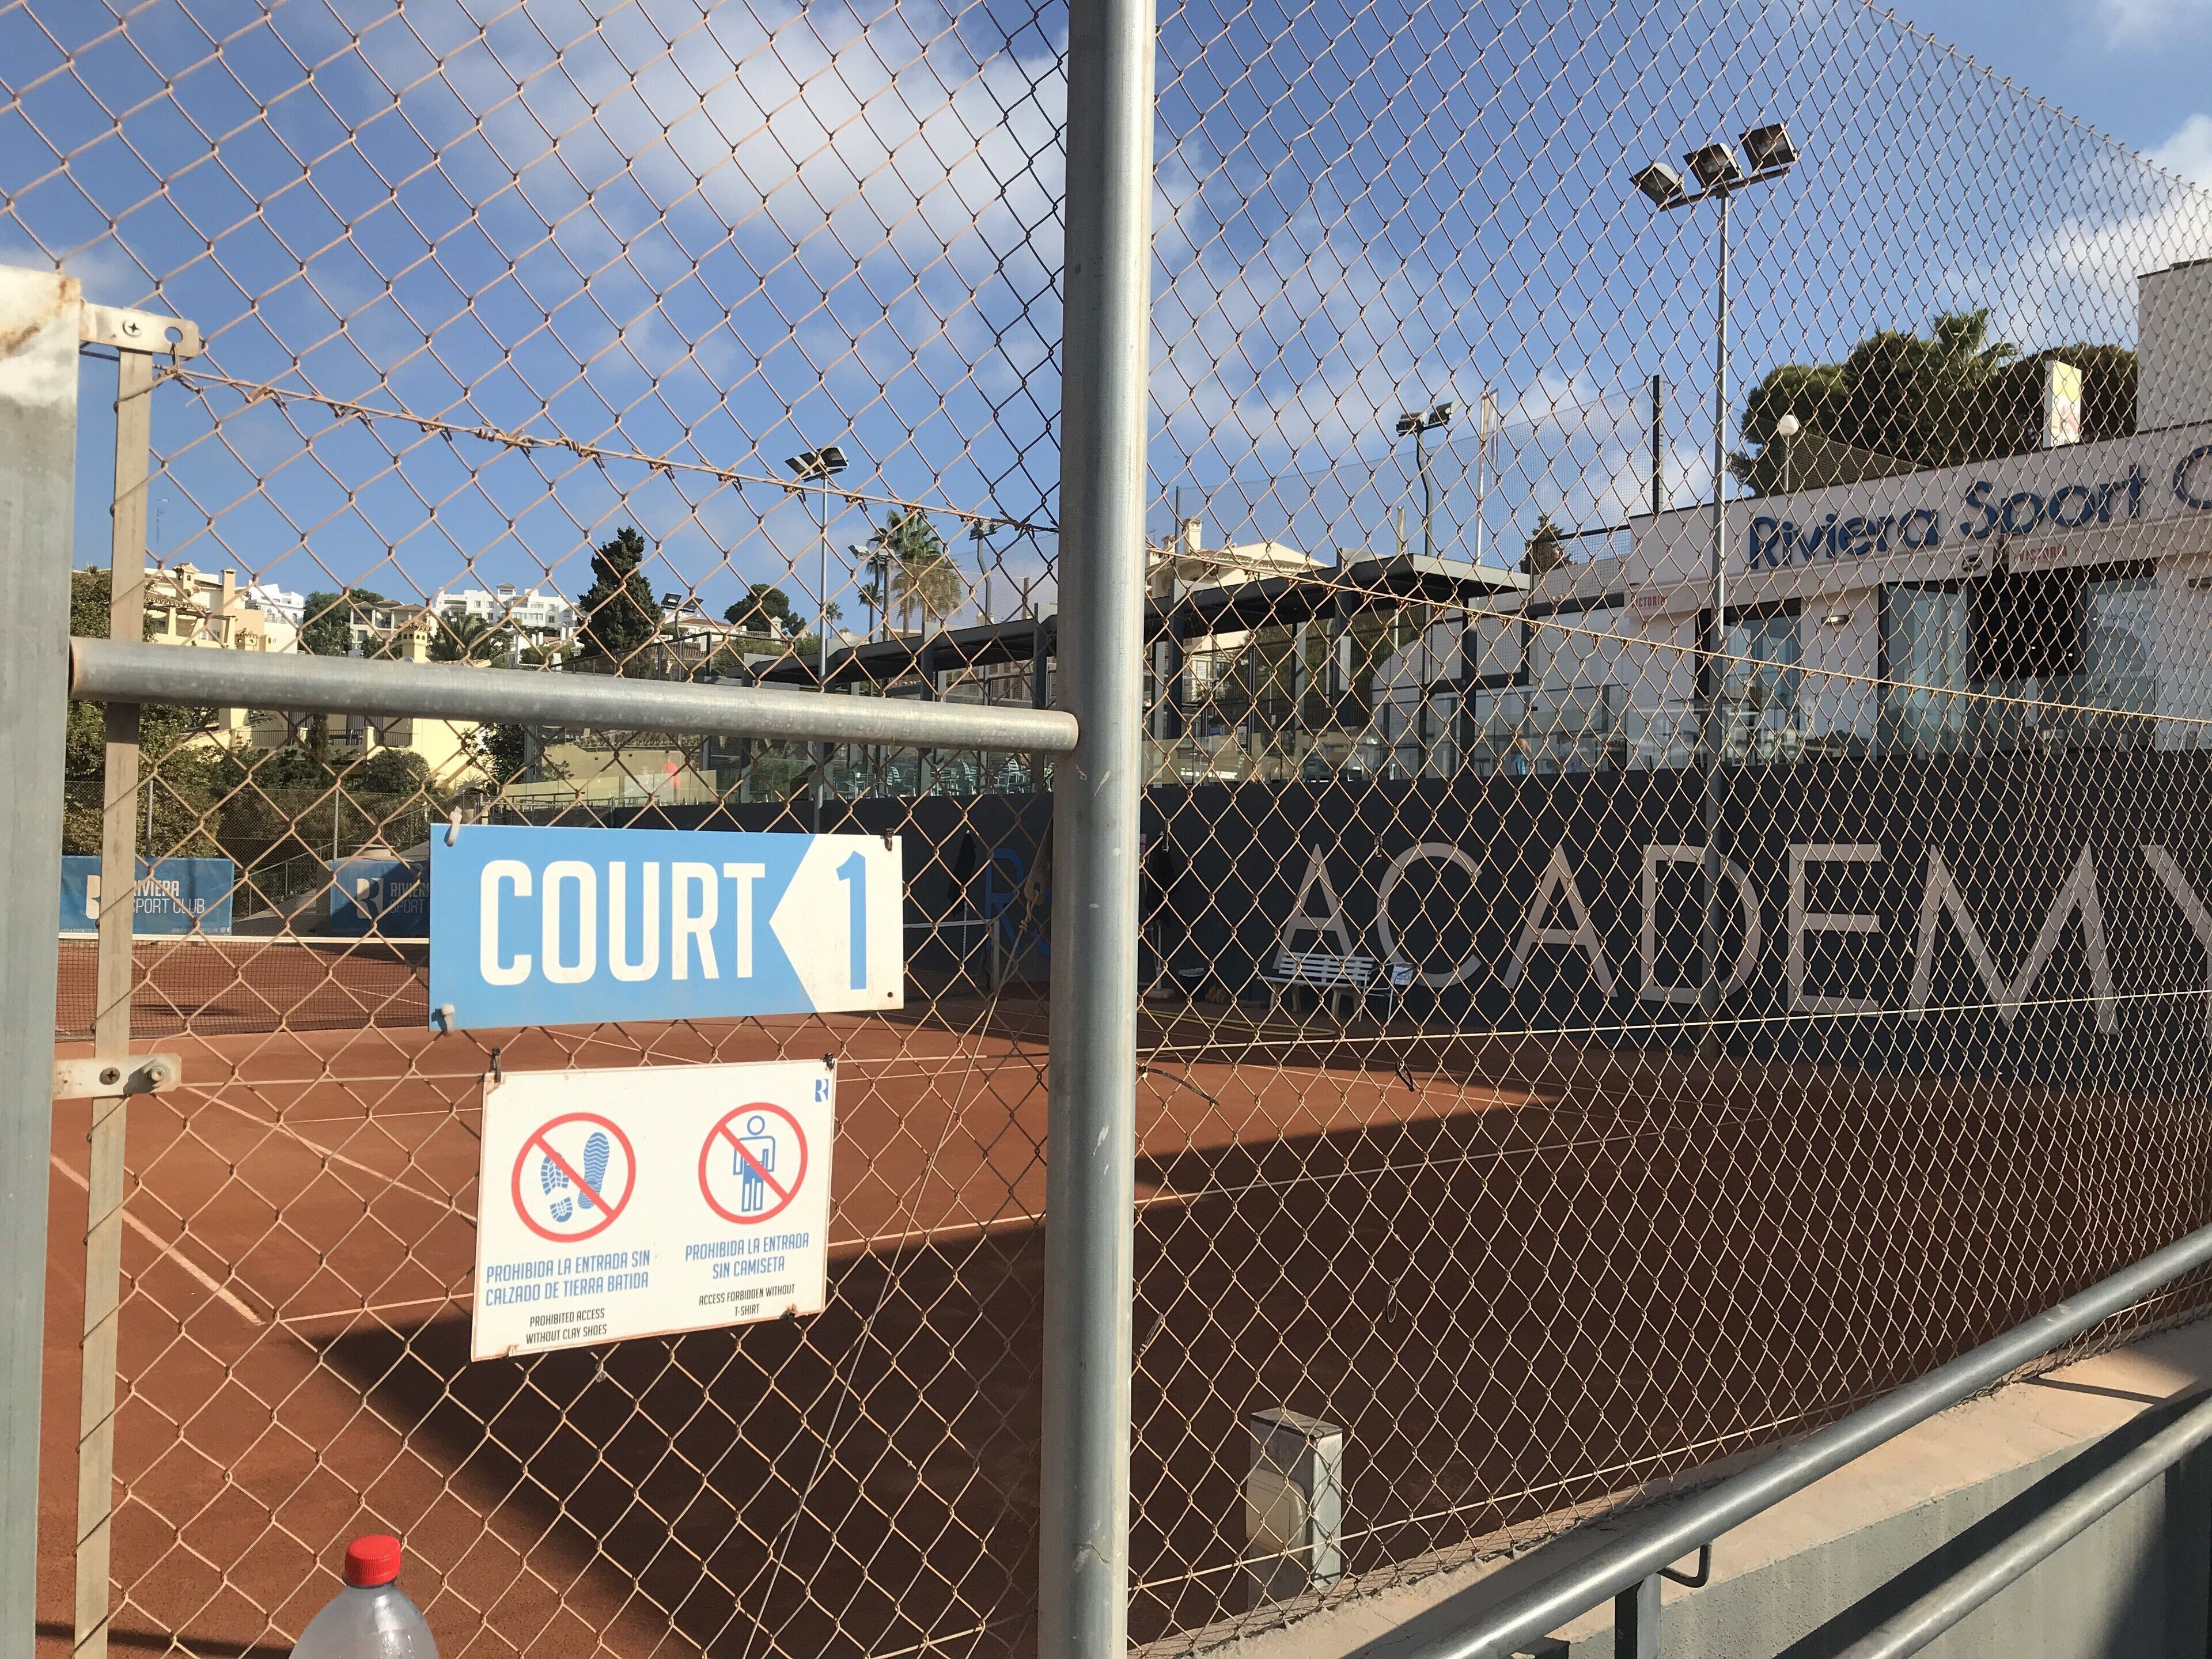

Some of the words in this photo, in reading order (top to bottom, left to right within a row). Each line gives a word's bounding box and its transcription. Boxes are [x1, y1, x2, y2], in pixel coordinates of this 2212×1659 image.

[1749, 507, 1939, 569] Riviera
[1960, 465, 2147, 539] Sport
[133, 898, 171, 914] PORT
[172, 898, 205, 914] CLUB
[390, 900, 425, 914] SPORT
[479, 859, 766, 986] COURT
[836, 850, 867, 991] 1
[685, 1240, 744, 1262] PROHIBIDA
[748, 1238, 760, 1254] LA
[763, 1232, 809, 1252] ENTRADA
[486, 1260, 554, 1283] PROHIBIDA
[558, 1258, 571, 1275] LA
[576, 1252, 628, 1274] ENTRADA
[631, 1249, 650, 1267] SIN
[713, 1262, 730, 1279] SIN
[733, 1256, 785, 1277] CAMISETA
[544, 1282, 559, 1300] DE
[563, 1277, 603, 1297] TIERRA
[607, 1271, 649, 1292] BATIDA
[699, 1293, 725, 1306] ACCESS
[726, 1287, 764, 1302] FORBIDDEN
[766, 1283, 795, 1297] WITHOUT
[530, 1311, 574, 1327] PROHIBITED
[577, 1308, 605, 1321] ACCESS
[734, 1304, 760, 1316] T-SHIRT
[526, 1330, 560, 1344] WITHOUT
[562, 1328, 581, 1340] CLAY
[583, 1324, 607, 1337] SHOES
